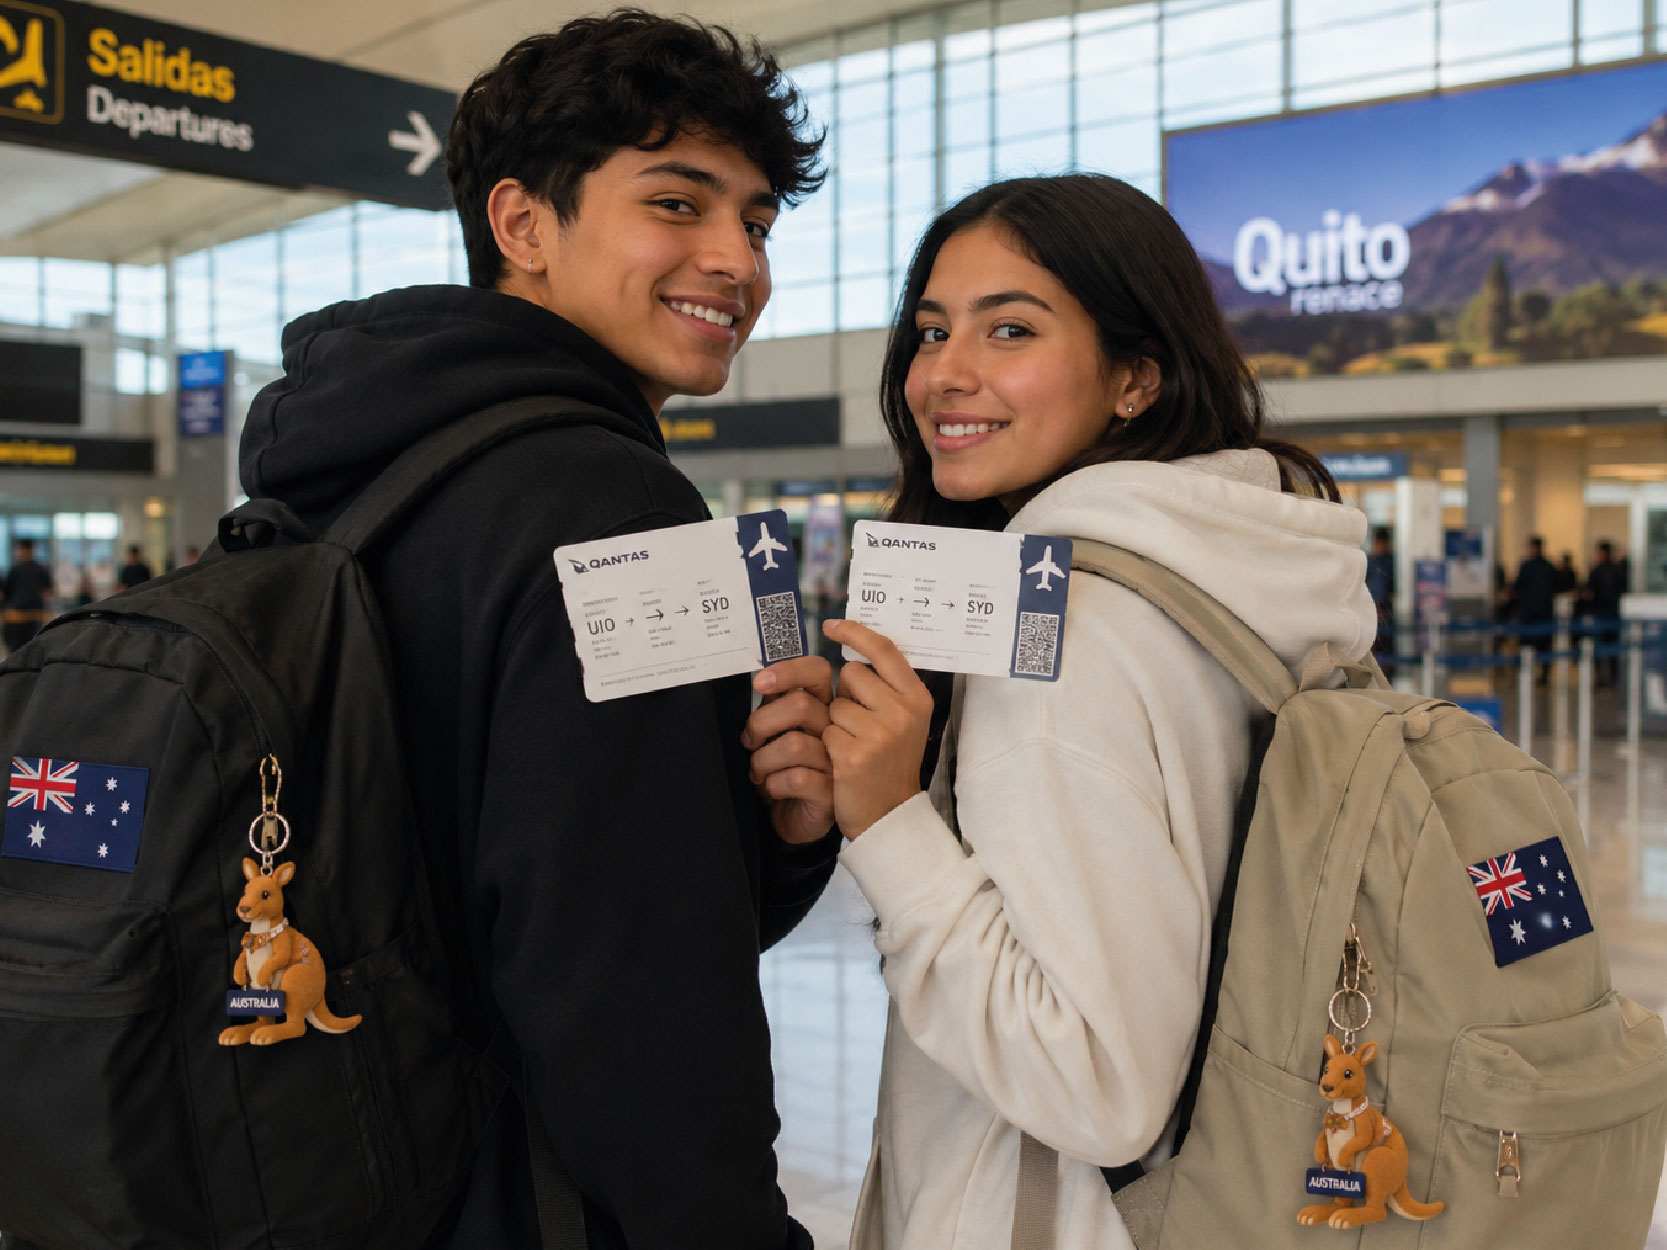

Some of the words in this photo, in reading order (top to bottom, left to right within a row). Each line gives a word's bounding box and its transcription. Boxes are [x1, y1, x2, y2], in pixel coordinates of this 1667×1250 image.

[88, 28, 236, 104] Salidas
[87, 84, 254, 153] Departures
[1235, 210, 1411, 295] Quito
[1290, 281, 1404, 316] renace
[881, 537, 937, 551] QANTAS
[589, 549, 650, 569] QANTAS
[701, 596, 730, 614] SYD
[861, 588, 887, 604] UIO
[967, 599, 995, 615] SYD
[587, 618, 616, 636] UIO
[230, 997, 280, 1009] AUSTRALIA
[1308, 1176, 1361, 1193] AUSTRALIA
